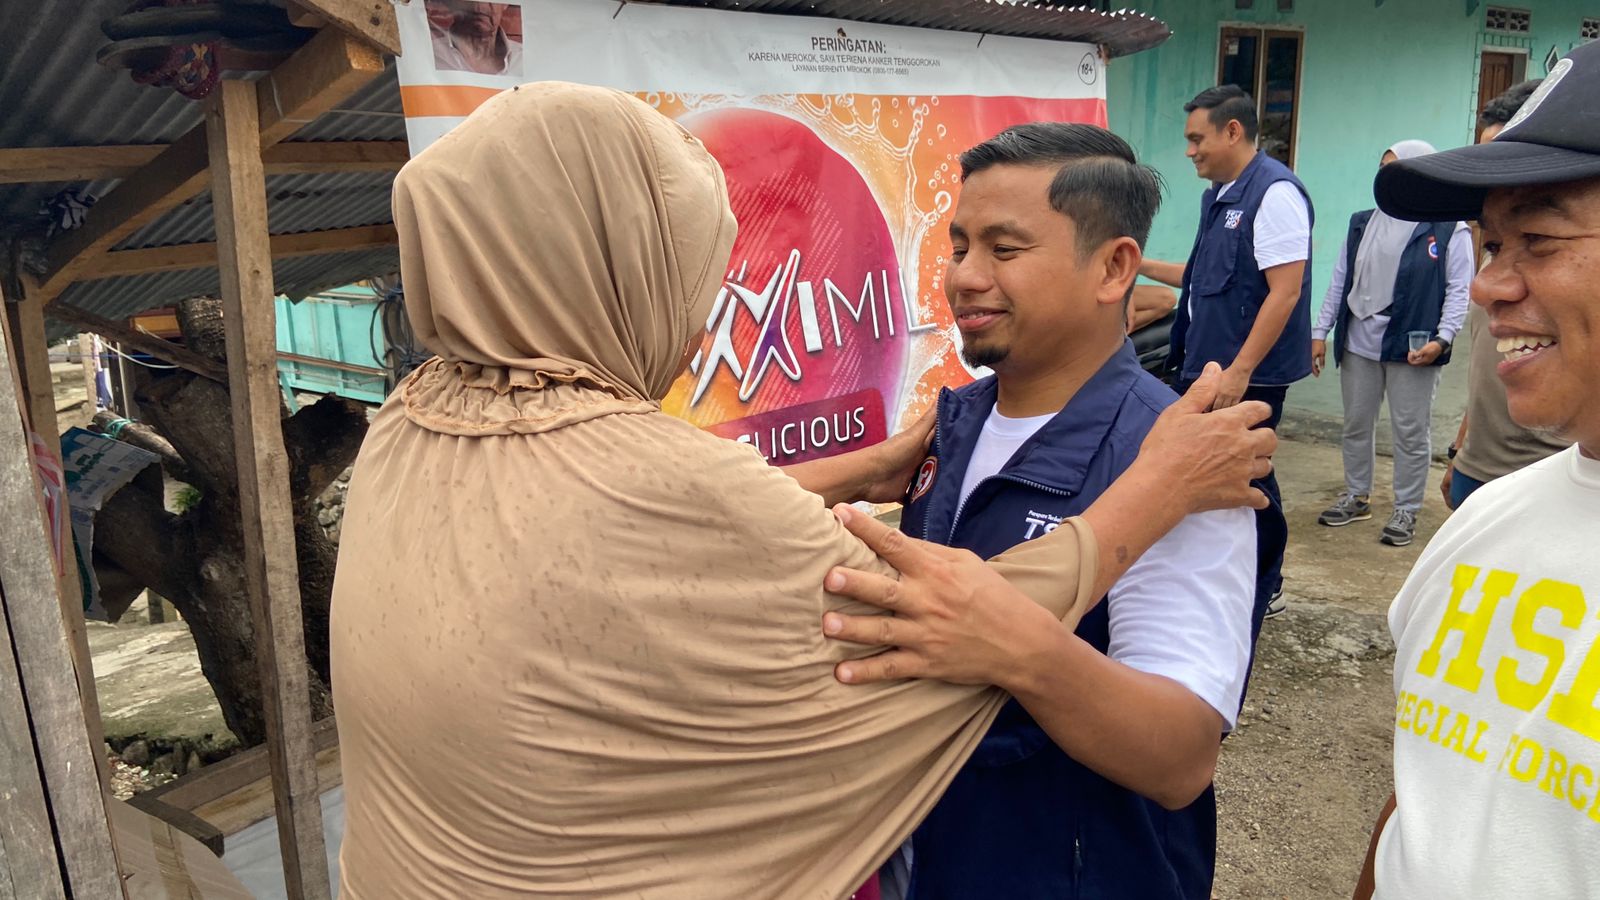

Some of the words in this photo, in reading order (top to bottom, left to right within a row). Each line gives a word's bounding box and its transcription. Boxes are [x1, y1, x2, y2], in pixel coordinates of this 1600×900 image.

[811, 36, 887, 54] PERINGATAN:
[748, 52, 781, 62] KARENA
[782, 53, 819, 63] MEROKOK,
[820, 54, 836, 63] SAYA
[867, 57, 893, 66] KANKER
[893, 57, 941, 67] TENGGOROKAN
[1081, 63, 1094, 75] 18+
[736, 406, 865, 461] LICIOUS
